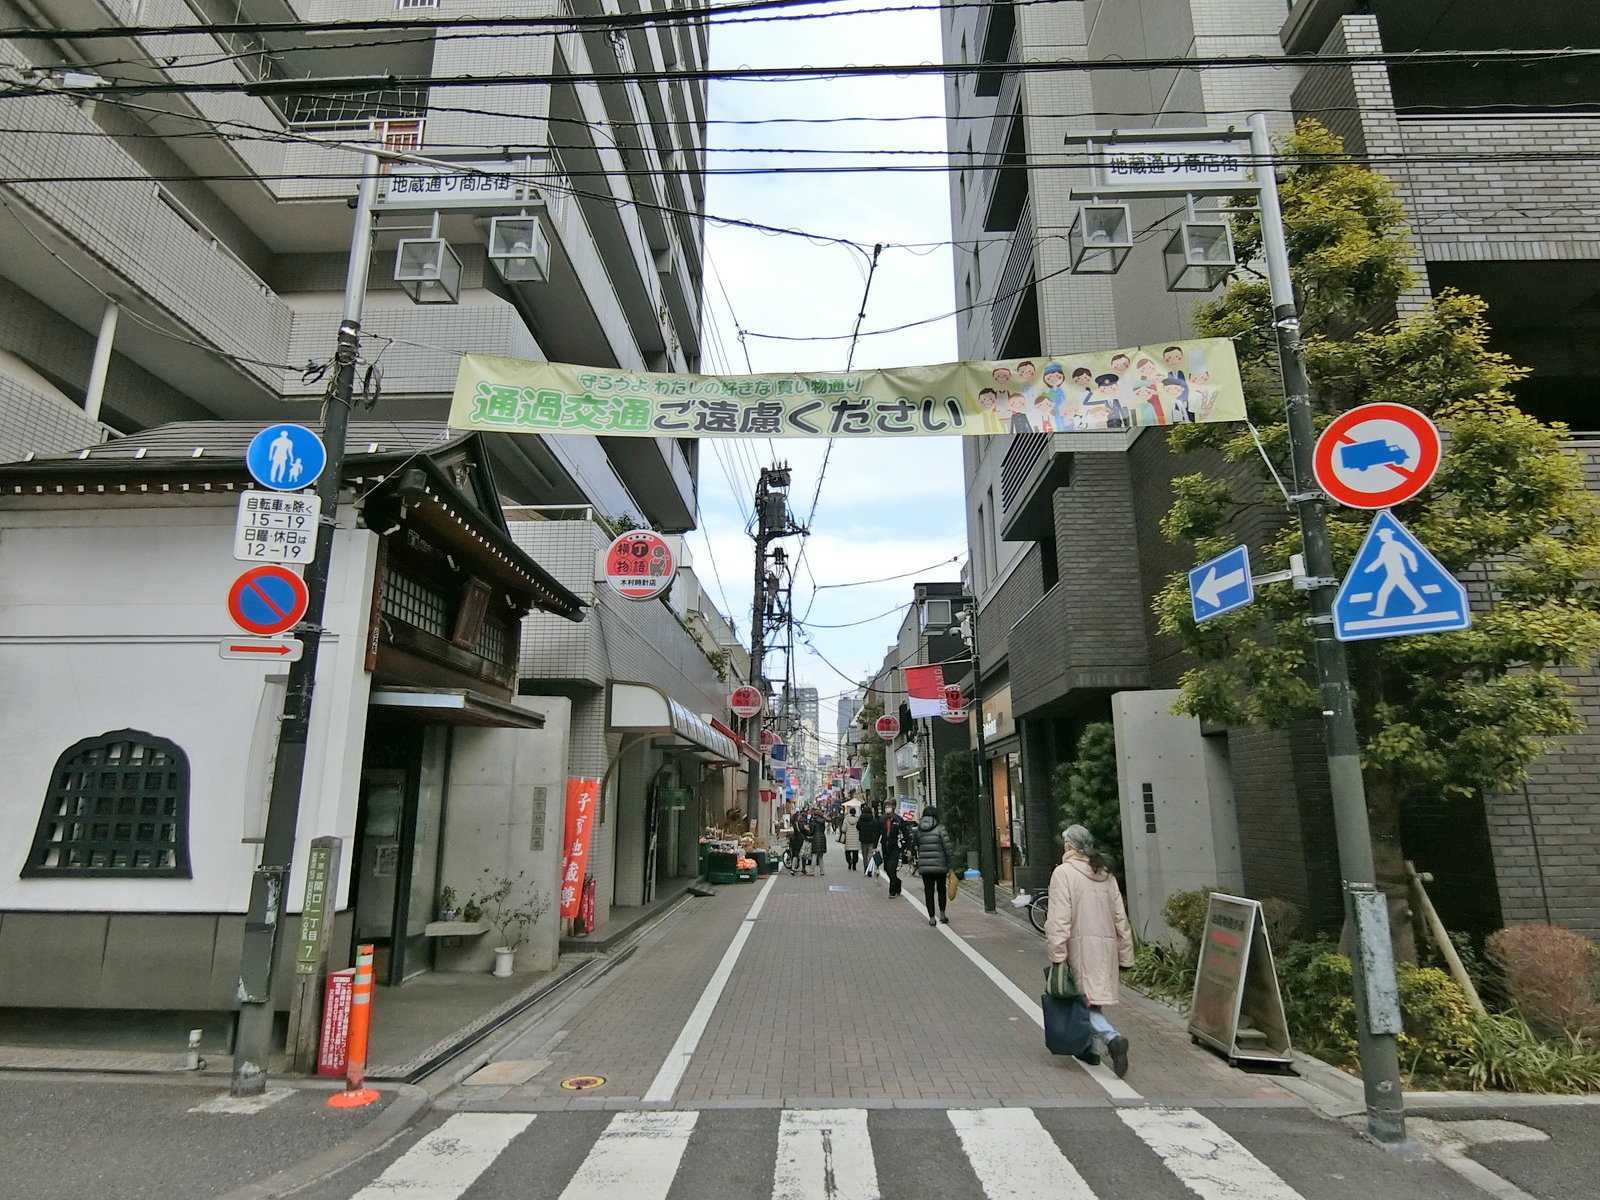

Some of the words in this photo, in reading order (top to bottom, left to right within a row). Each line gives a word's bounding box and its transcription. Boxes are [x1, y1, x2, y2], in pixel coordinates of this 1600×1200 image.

[1111, 154, 1238, 176] 地蔵通り商店街
[391, 174, 509, 193] 地蔵通り商店街
[579, 374, 649, 393] 守ろうよ
[472, 383, 964, 433] 通過交通ご遠慮ください
[247, 497, 313, 514] 自転車を除く
[252, 513, 305, 529] 15-19
[244, 528, 307, 545] 日曜・休日は
[248, 542, 301, 558] 12-19
[620, 579, 657, 587] 木村時計店
[937, 693, 949, 716] 2020
[305, 945, 313, 958] 7
